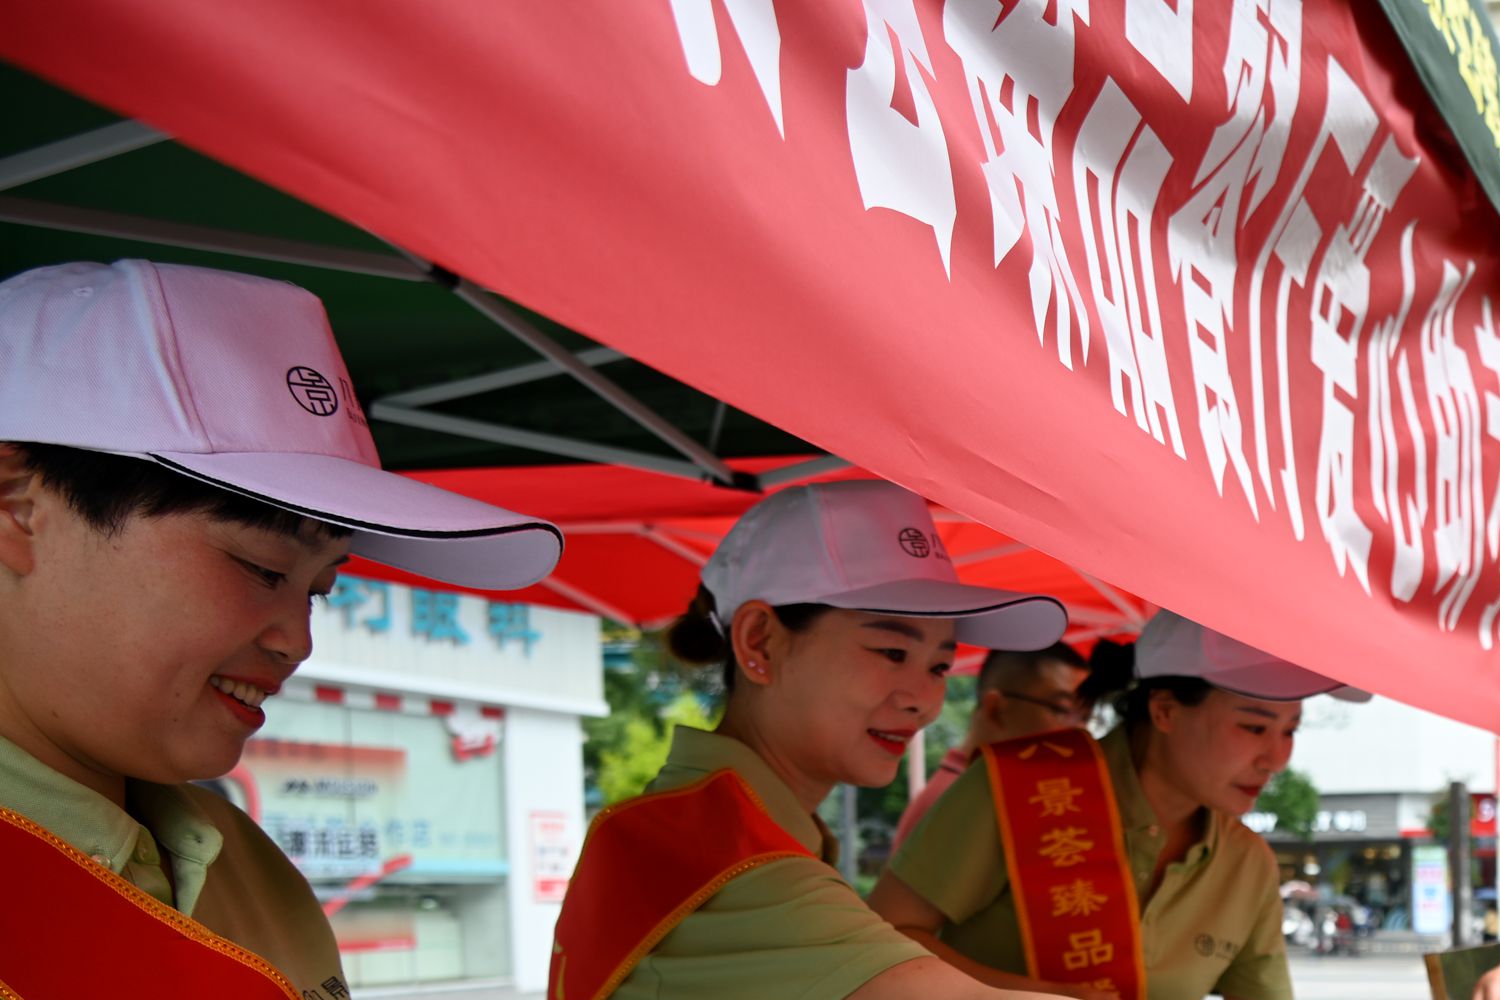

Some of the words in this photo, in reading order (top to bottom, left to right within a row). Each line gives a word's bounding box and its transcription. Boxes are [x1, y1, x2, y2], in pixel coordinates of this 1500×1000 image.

[1018, 742, 1118, 996] 八景荟臻品
